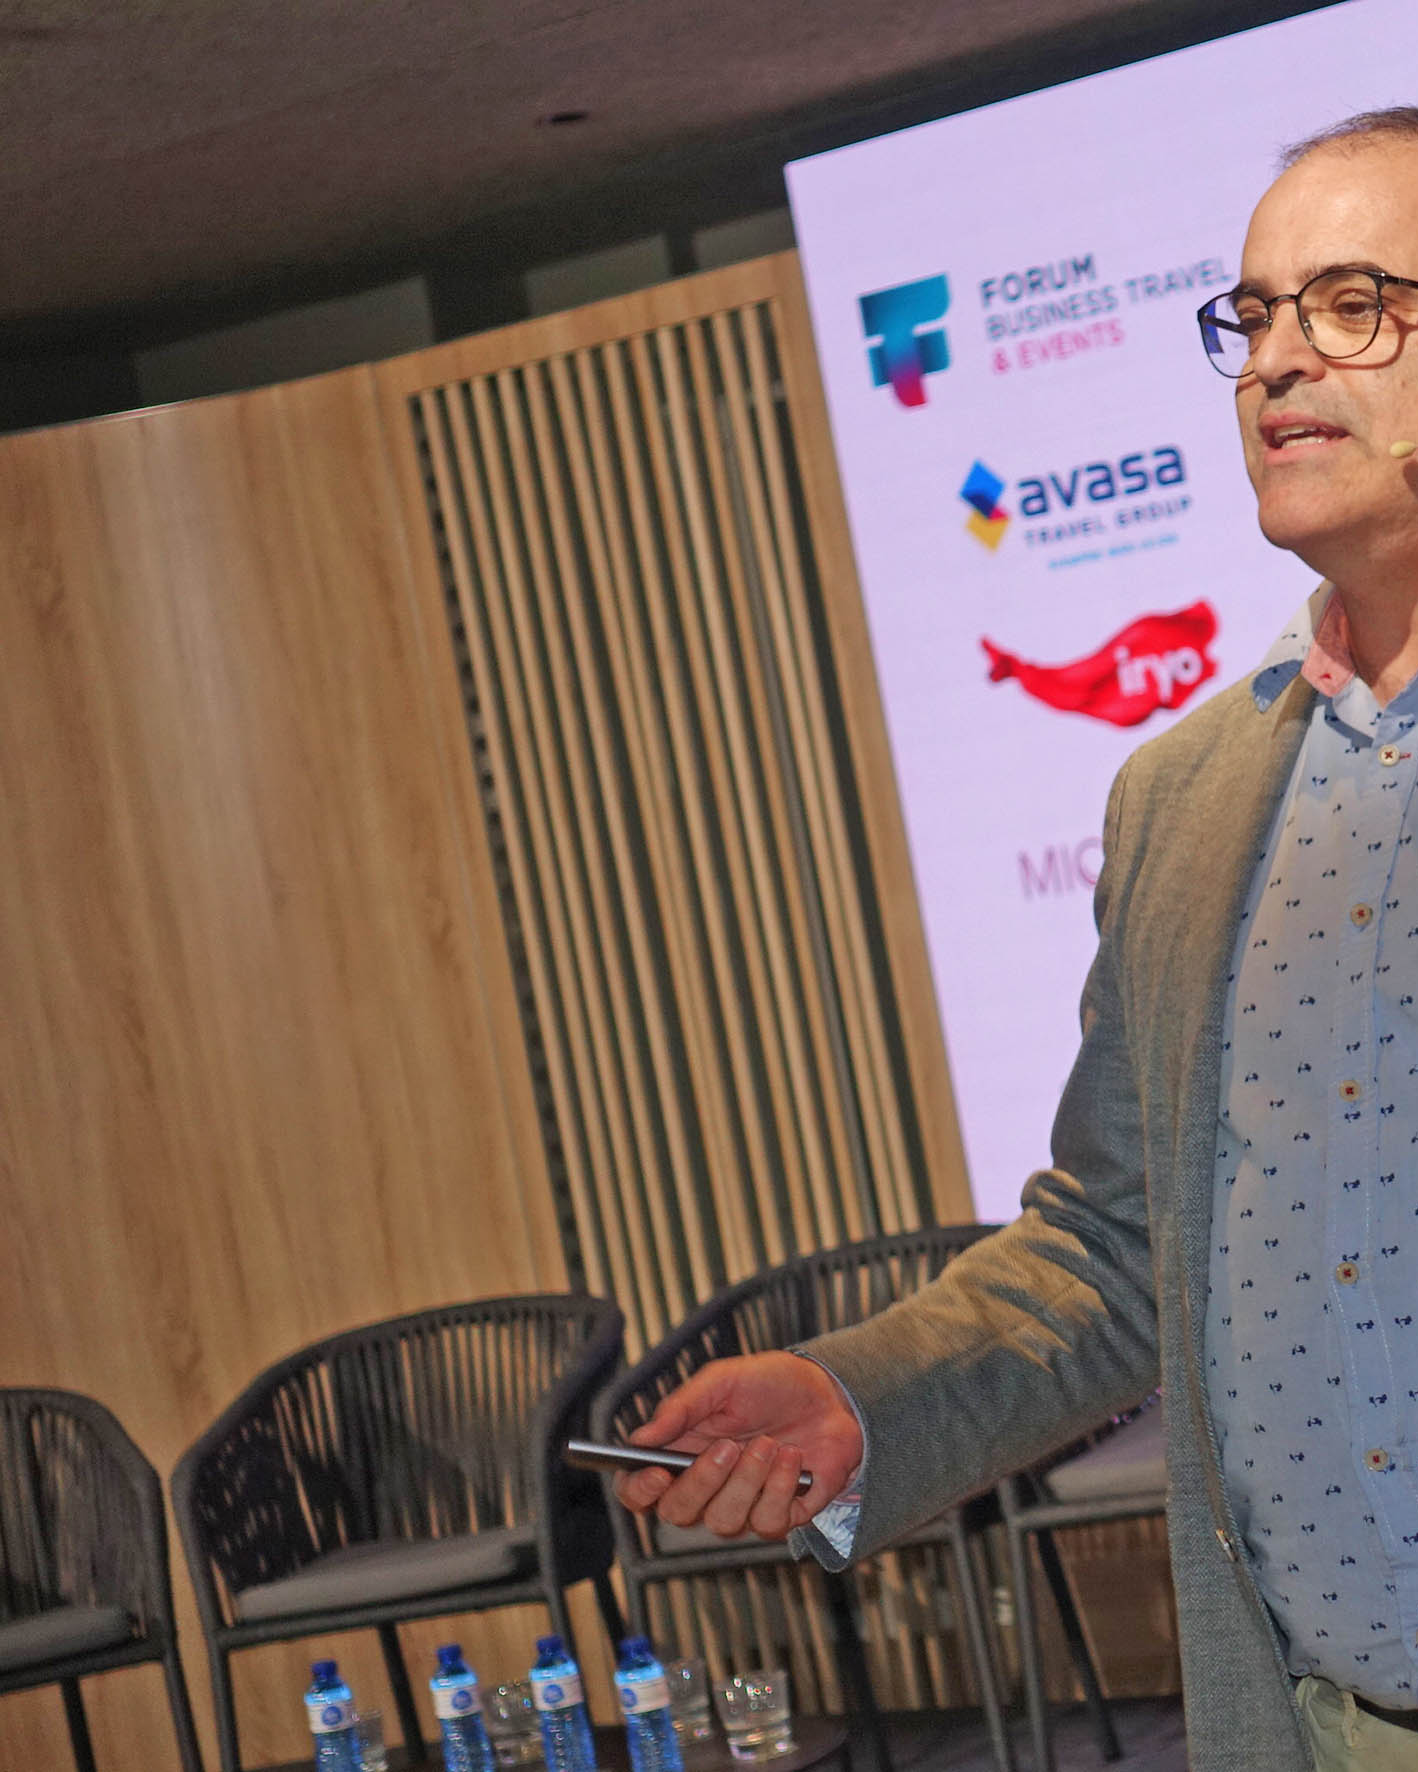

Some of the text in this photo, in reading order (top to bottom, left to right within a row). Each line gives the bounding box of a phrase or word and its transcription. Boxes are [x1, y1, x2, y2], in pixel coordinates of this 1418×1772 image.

[979, 253, 1097, 308] FORUM
[986, 257, 1233, 341] BUSINESS TRAVEL
[993, 318, 1125, 373] & EVENTS
[1017, 444, 1188, 518] avasa
[1024, 495, 1193, 547] TRAVEL GROUP
